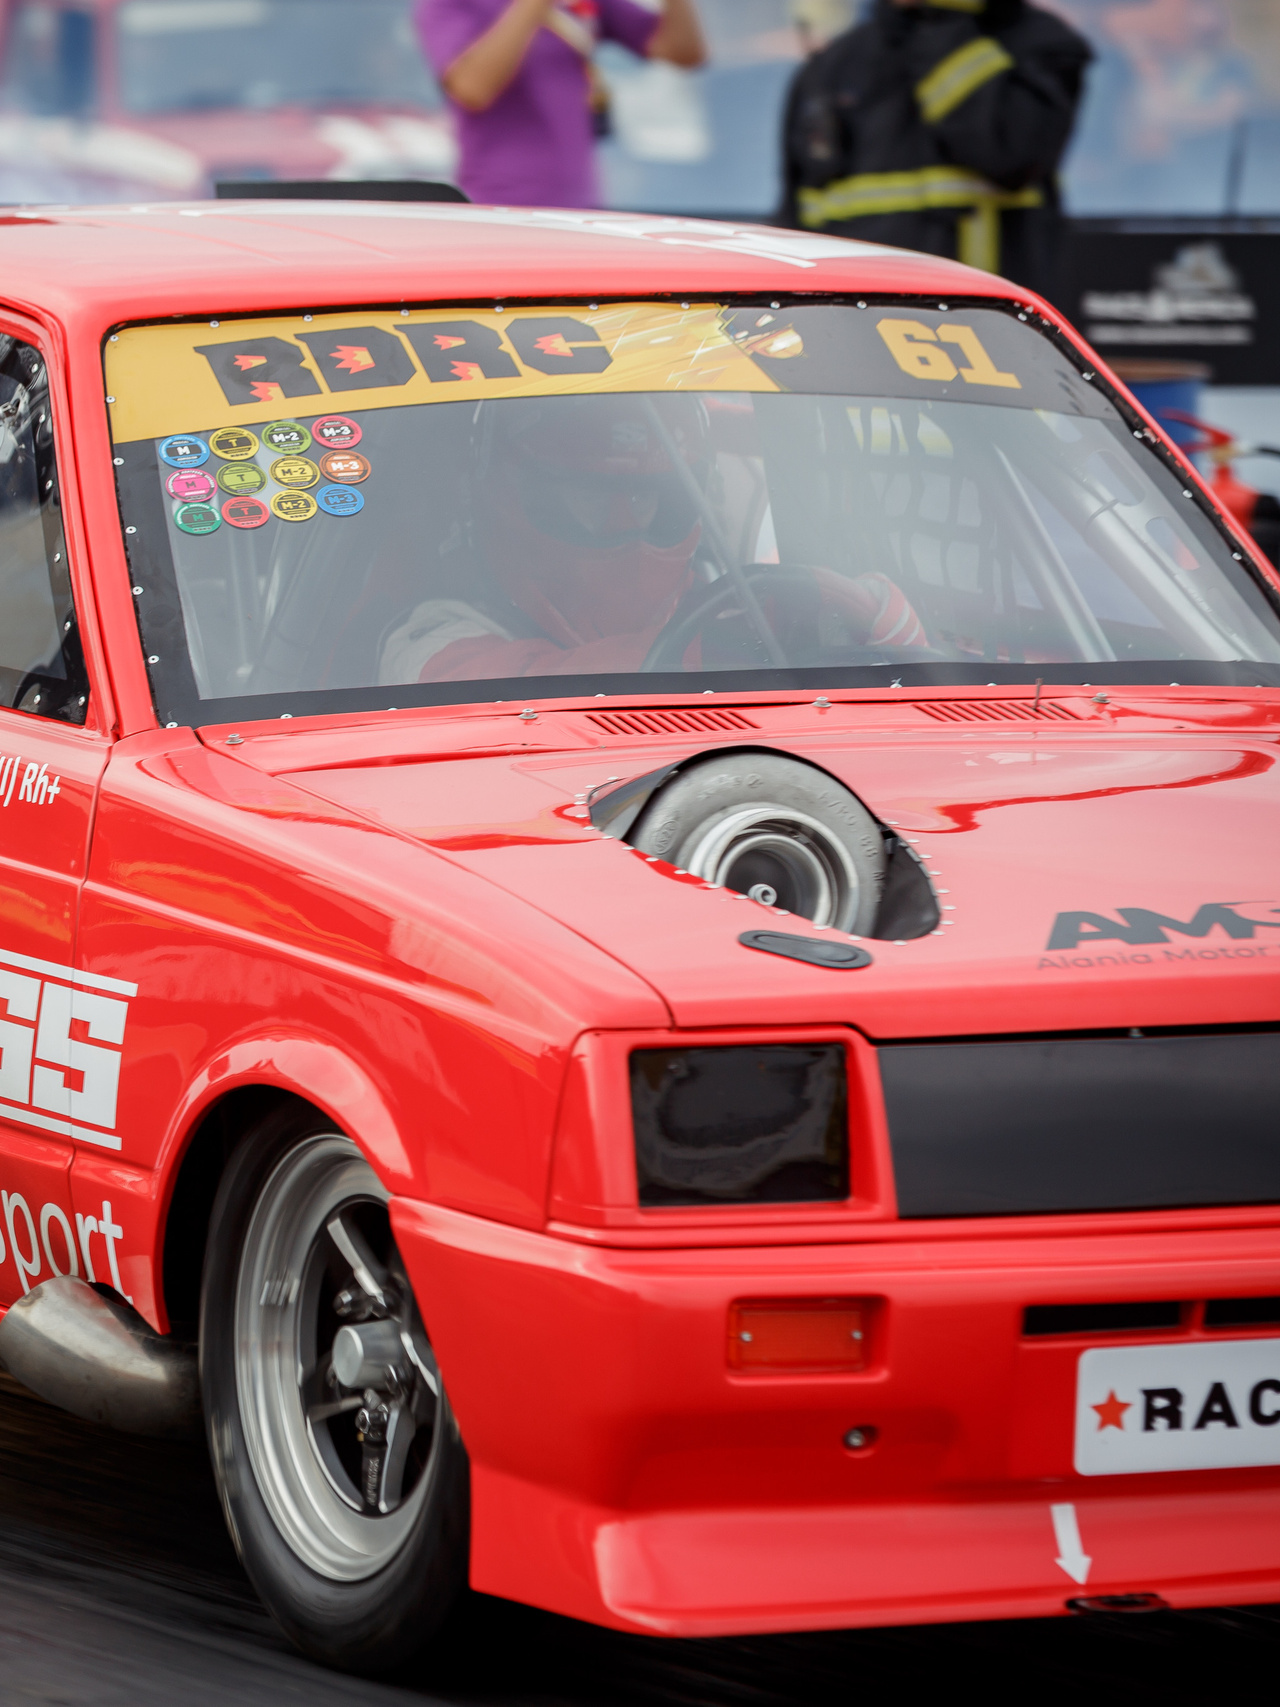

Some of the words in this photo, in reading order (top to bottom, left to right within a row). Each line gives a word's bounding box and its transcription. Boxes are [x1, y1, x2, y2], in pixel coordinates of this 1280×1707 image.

[876, 318, 1022, 389] 61
[193, 316, 614, 406] RDRC
[322, 426, 351, 437] M-3
[272, 432, 299, 443] M-2
[177, 445, 191, 456] M
[281, 467, 307, 476] M-2
[330, 461, 360, 471] M-3
[185, 481, 197, 489] M
[327, 494, 355, 504] M-3
[280, 500, 307, 510] M-2
[192, 513, 204, 522] M
[18, 762, 61, 806] Rh+
[1037, 952, 1153, 970] Alania
[1163, 946, 1270, 963] Motor
[1140, 1379, 1280, 1432] RAC
